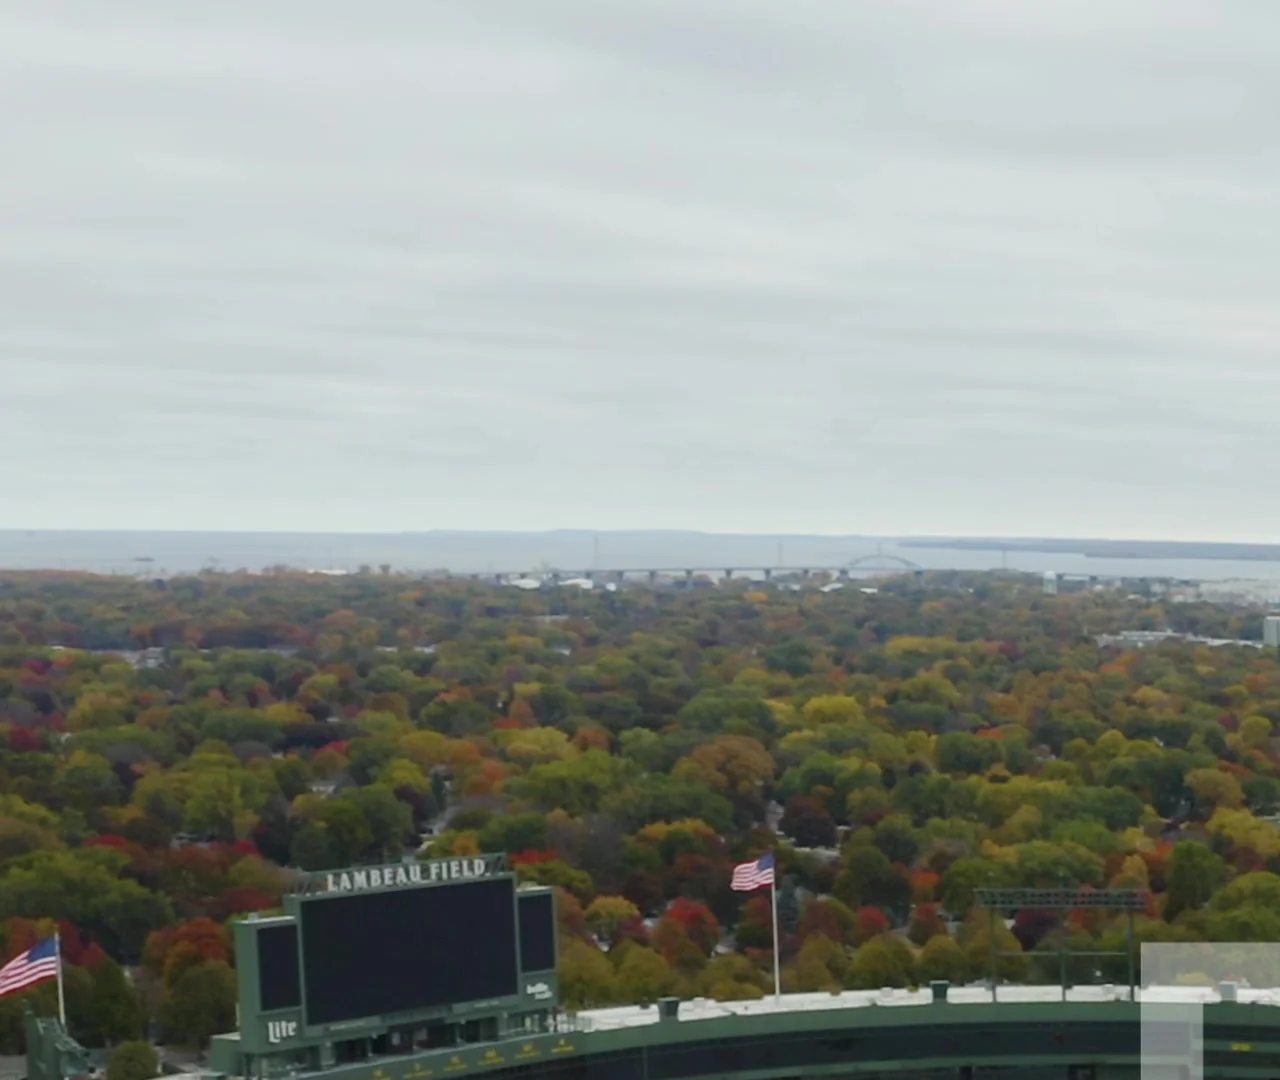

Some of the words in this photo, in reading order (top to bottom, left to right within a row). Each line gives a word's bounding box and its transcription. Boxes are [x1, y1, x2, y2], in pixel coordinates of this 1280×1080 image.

[327, 863, 422, 892] LAMBEAU
[430, 858, 487, 881] FIELD
[268, 1020, 297, 1043] Lite
